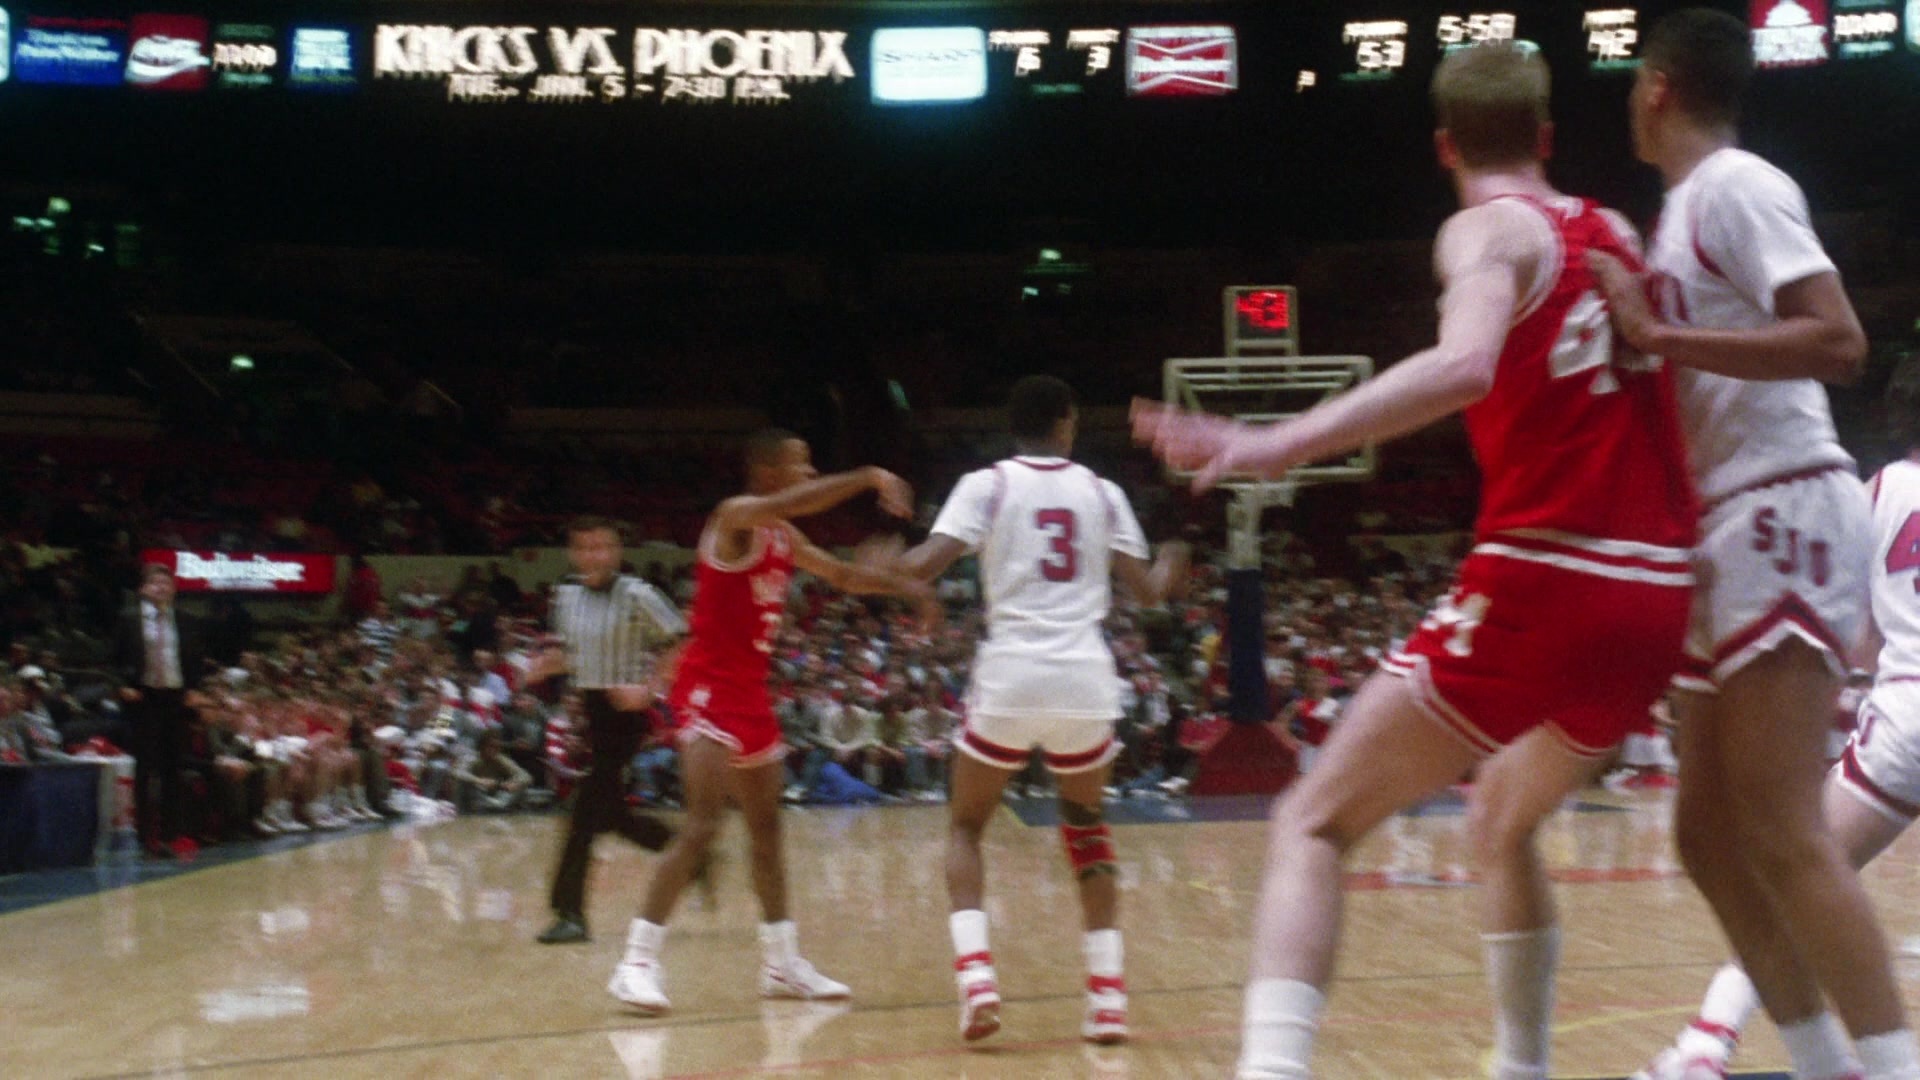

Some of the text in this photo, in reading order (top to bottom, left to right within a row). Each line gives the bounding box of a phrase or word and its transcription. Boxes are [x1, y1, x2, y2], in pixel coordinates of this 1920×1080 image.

[374, 24, 538, 75] KNICKS
[634, 28, 855, 77] PHOENIX
[1034, 508, 1079, 582] 3
